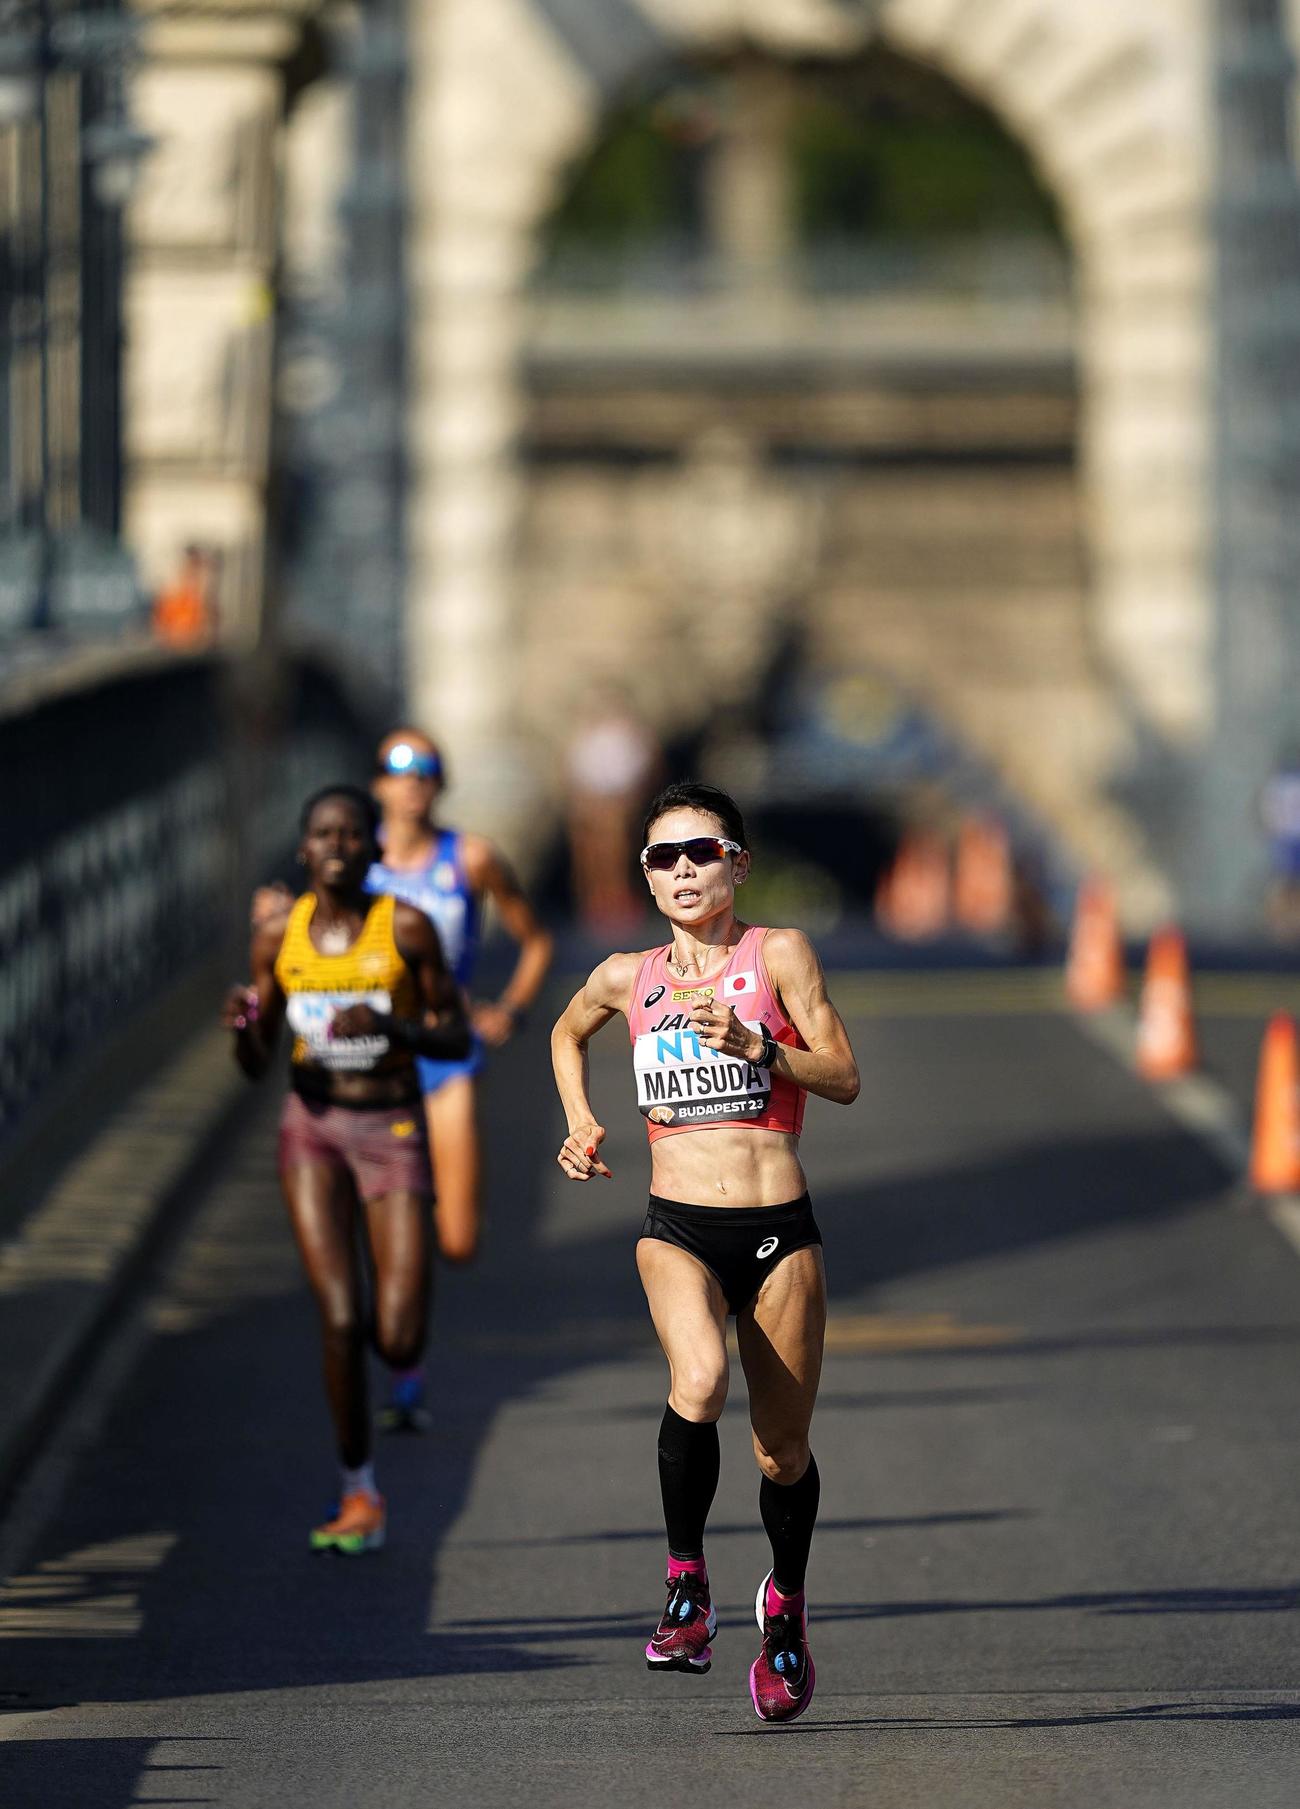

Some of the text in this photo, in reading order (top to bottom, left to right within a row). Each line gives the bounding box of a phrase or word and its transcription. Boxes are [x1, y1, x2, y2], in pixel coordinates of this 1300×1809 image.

[656, 1030, 719, 1064] NT
[643, 1063, 763, 1101] MATSUDA
[678, 1098, 764, 1118] BUDAPEST 23
